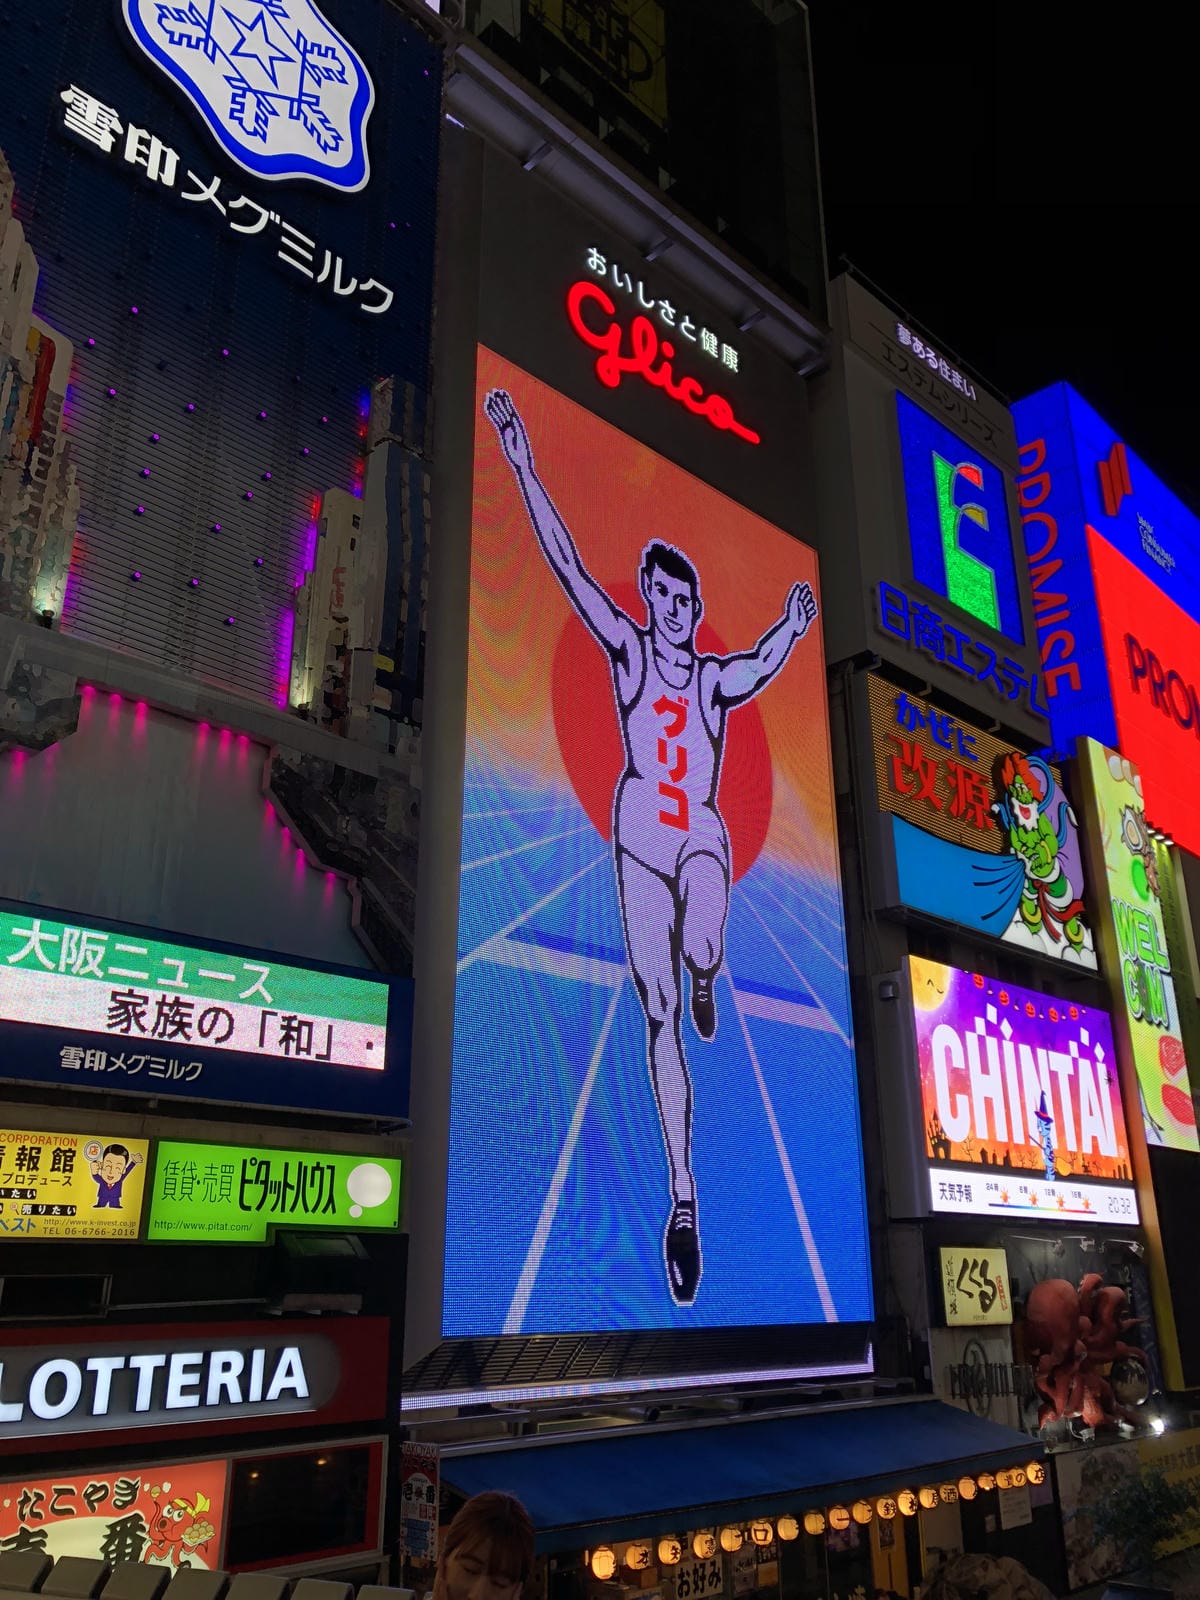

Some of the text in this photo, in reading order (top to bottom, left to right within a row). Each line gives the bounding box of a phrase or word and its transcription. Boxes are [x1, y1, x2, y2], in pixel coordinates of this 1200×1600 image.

[60, 84, 393, 313] 雪印メグミルク
[587, 247, 739, 373] おいしさと健康
[568, 281, 760, 444] Glico
[1123, 632, 1200, 743] PRO
[652, 694, 690, 832] グリコ
[895, 692, 979, 762] かぜに
[886, 736, 994, 830] 改源
[7, 919, 273, 1004] 大阪ニュース
[106, 988, 332, 1061] 家族の「和」
[60, 1045, 203, 1082] 雪印メグミルク
[931, 1003, 1118, 1158] CHINTAI
[2, 1173, 73, 1187] プロデュース
[239, 1157, 337, 1215] ピタットハウス
[939, 1182, 974, 1203] 天気予報
[43, 1226, 136, 1237] TEL 06-6766-2016
[153, 1218, 254, 1233] http://www.pitat.com/
[0, 1346, 310, 1423] LOTTERIA
